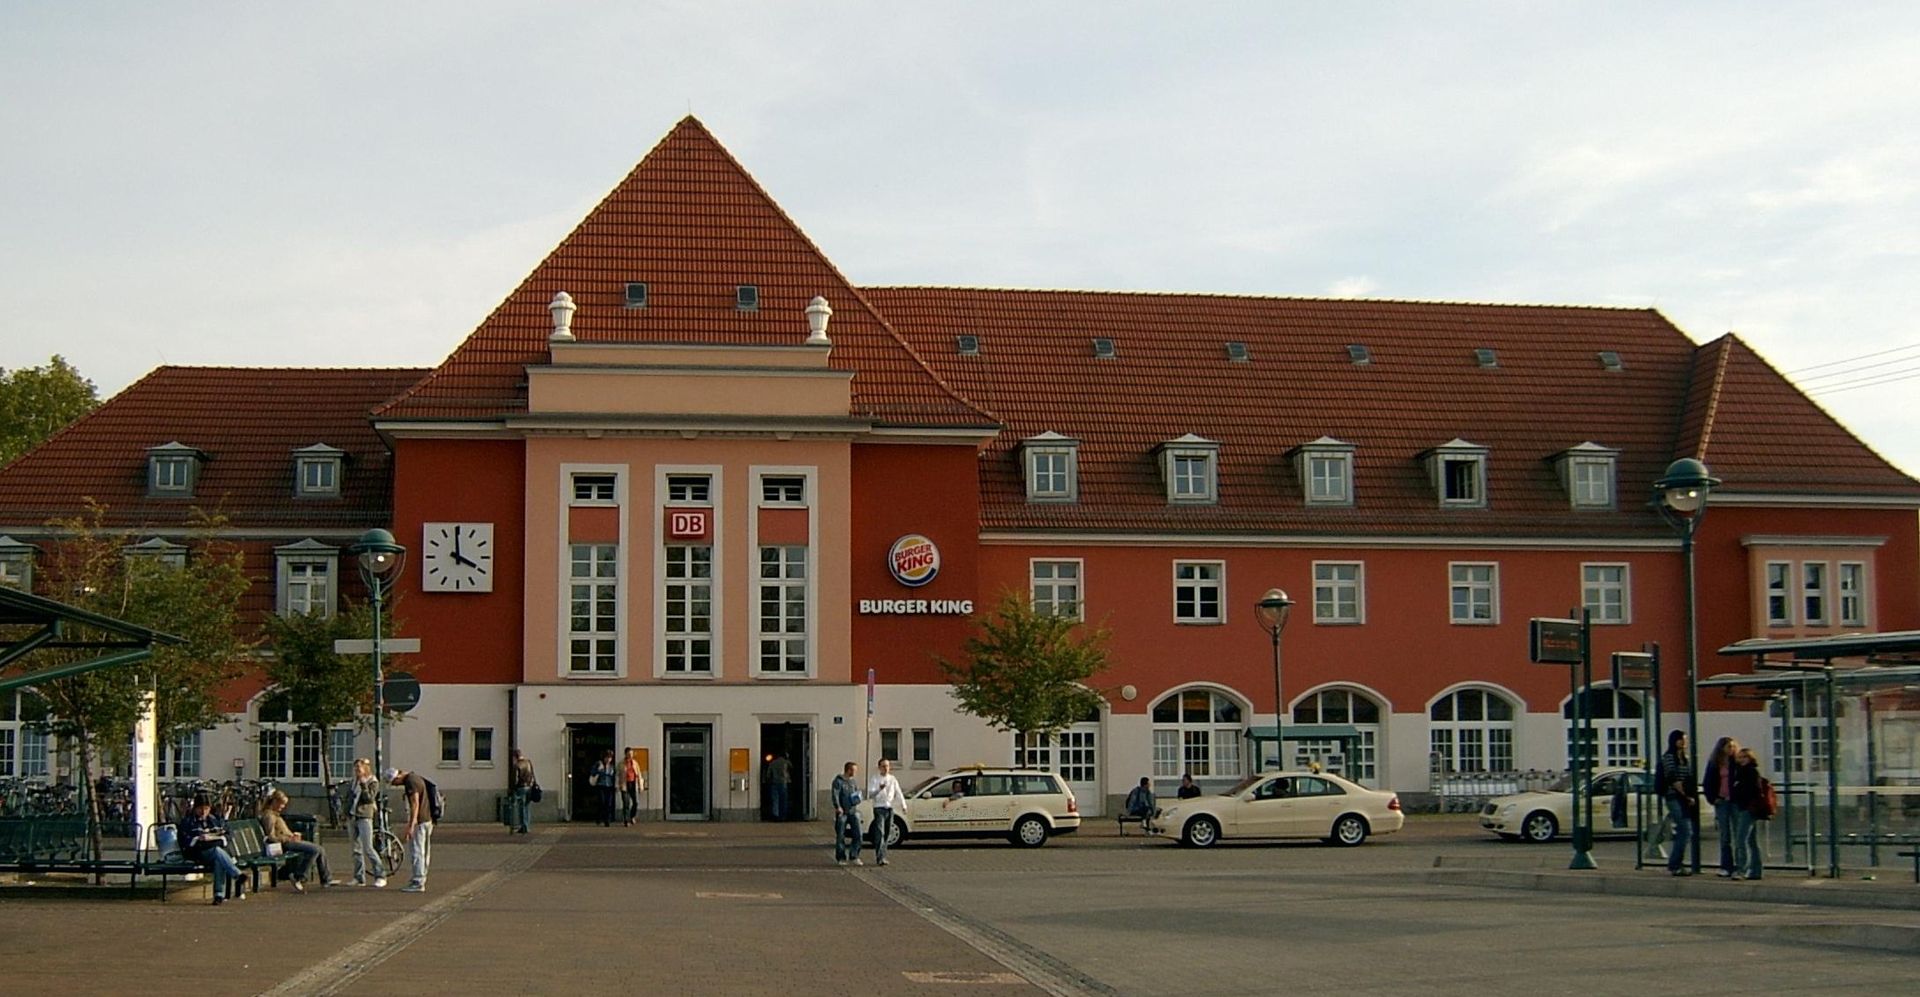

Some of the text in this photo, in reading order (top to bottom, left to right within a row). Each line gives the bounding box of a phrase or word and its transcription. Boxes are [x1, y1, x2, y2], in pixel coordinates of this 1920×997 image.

[675, 515, 702, 533] DB
[895, 543, 932, 562] BURGER
[897, 552, 934, 573] KING
[859, 599, 973, 614] BURGER KING
